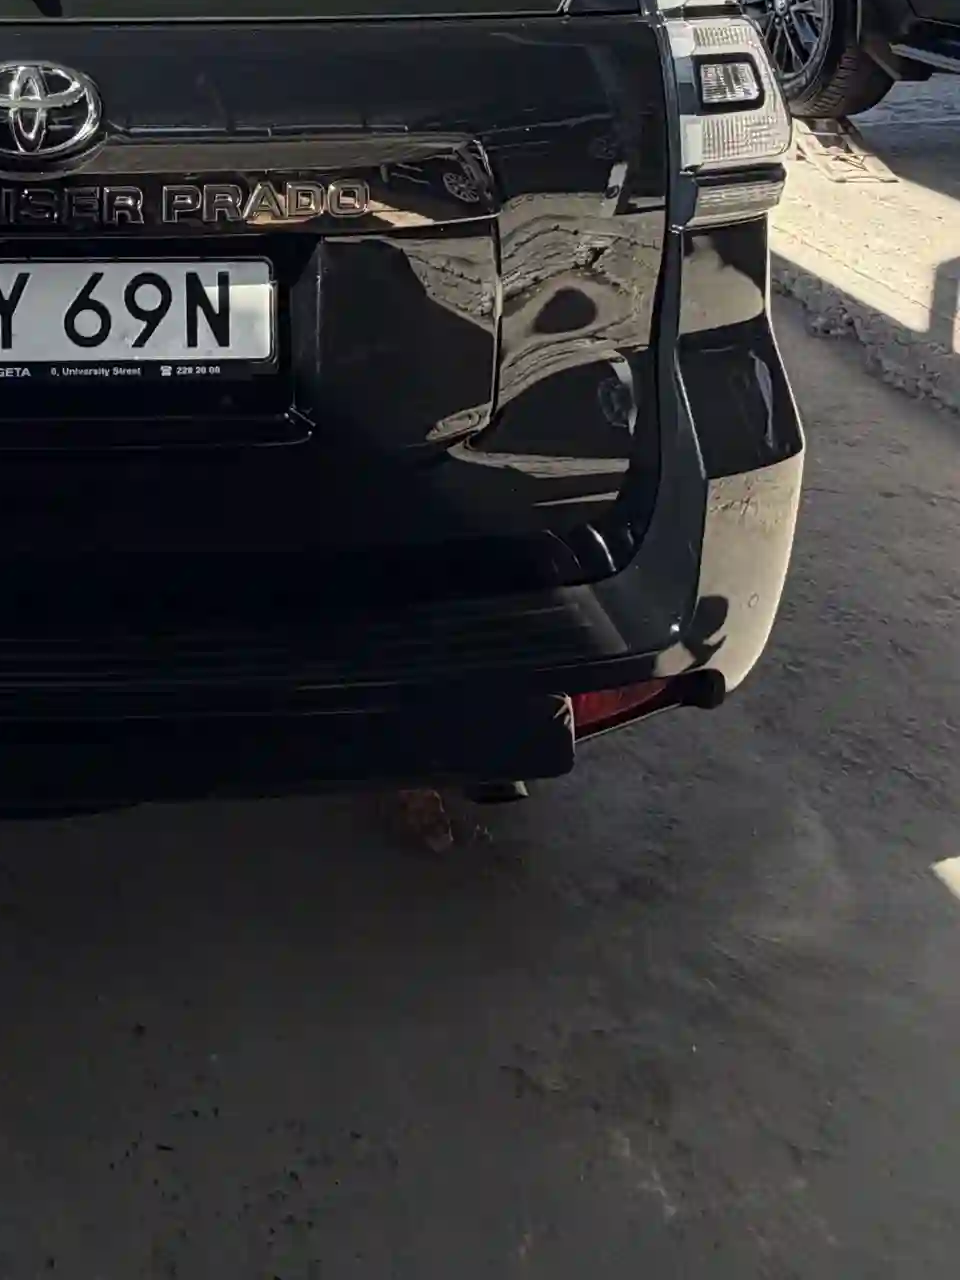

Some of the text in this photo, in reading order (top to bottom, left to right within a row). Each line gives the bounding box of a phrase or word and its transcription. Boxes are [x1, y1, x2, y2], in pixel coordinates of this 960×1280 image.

[161, 177, 371, 223] PRADO
[63, 271, 231, 349] 69N
[62, 366, 110, 378] University
